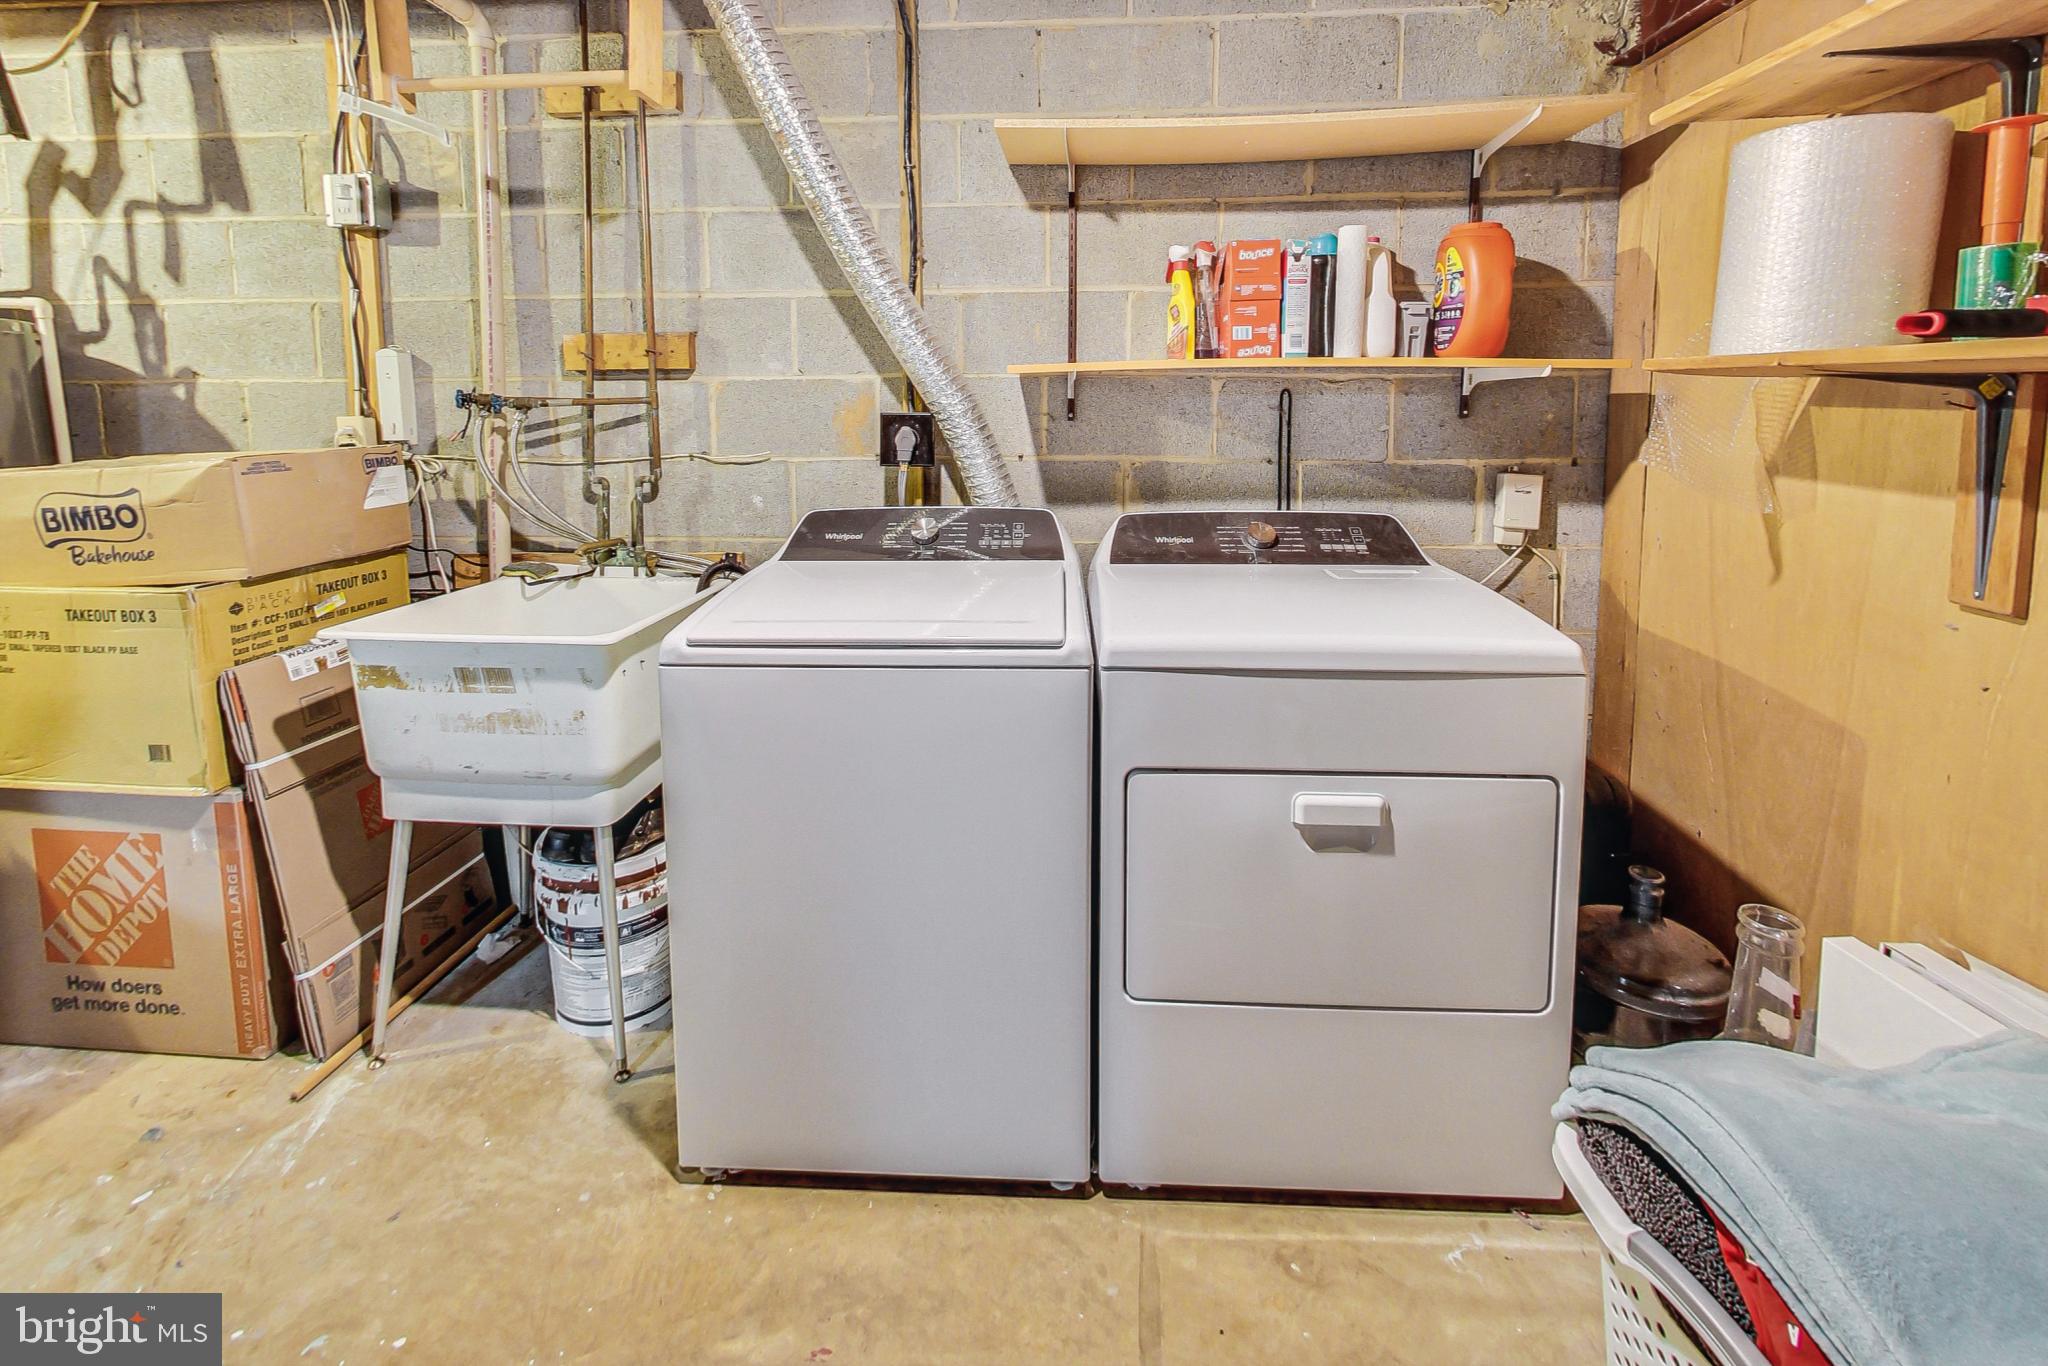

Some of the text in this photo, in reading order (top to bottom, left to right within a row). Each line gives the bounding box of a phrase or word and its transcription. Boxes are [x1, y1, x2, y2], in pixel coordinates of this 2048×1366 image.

[1239, 248, 1275, 260] bounce
[364, 456, 399, 469] BIMBO
[41, 504, 138, 532] BIMBO
[825, 532, 863, 542] Whirlpool
[1154, 535, 1194, 546] Whirlpool
[67, 545, 155, 566] Bakehouse
[316, 570, 388, 595] TAKEOUT BOX 3
[247, 596, 292, 613] PACK
[65, 609, 157, 623] TAKEOUT BOX 3
[49, 844, 100, 897] THE
[43, 832, 165, 965] HOME
[93, 884, 169, 966] DEPOT
[226, 863, 254, 1048] HEAVY DUTY EXTRA LARGE
[66, 975, 163, 995] How doers
[52, 996, 186, 1015] get more done.
